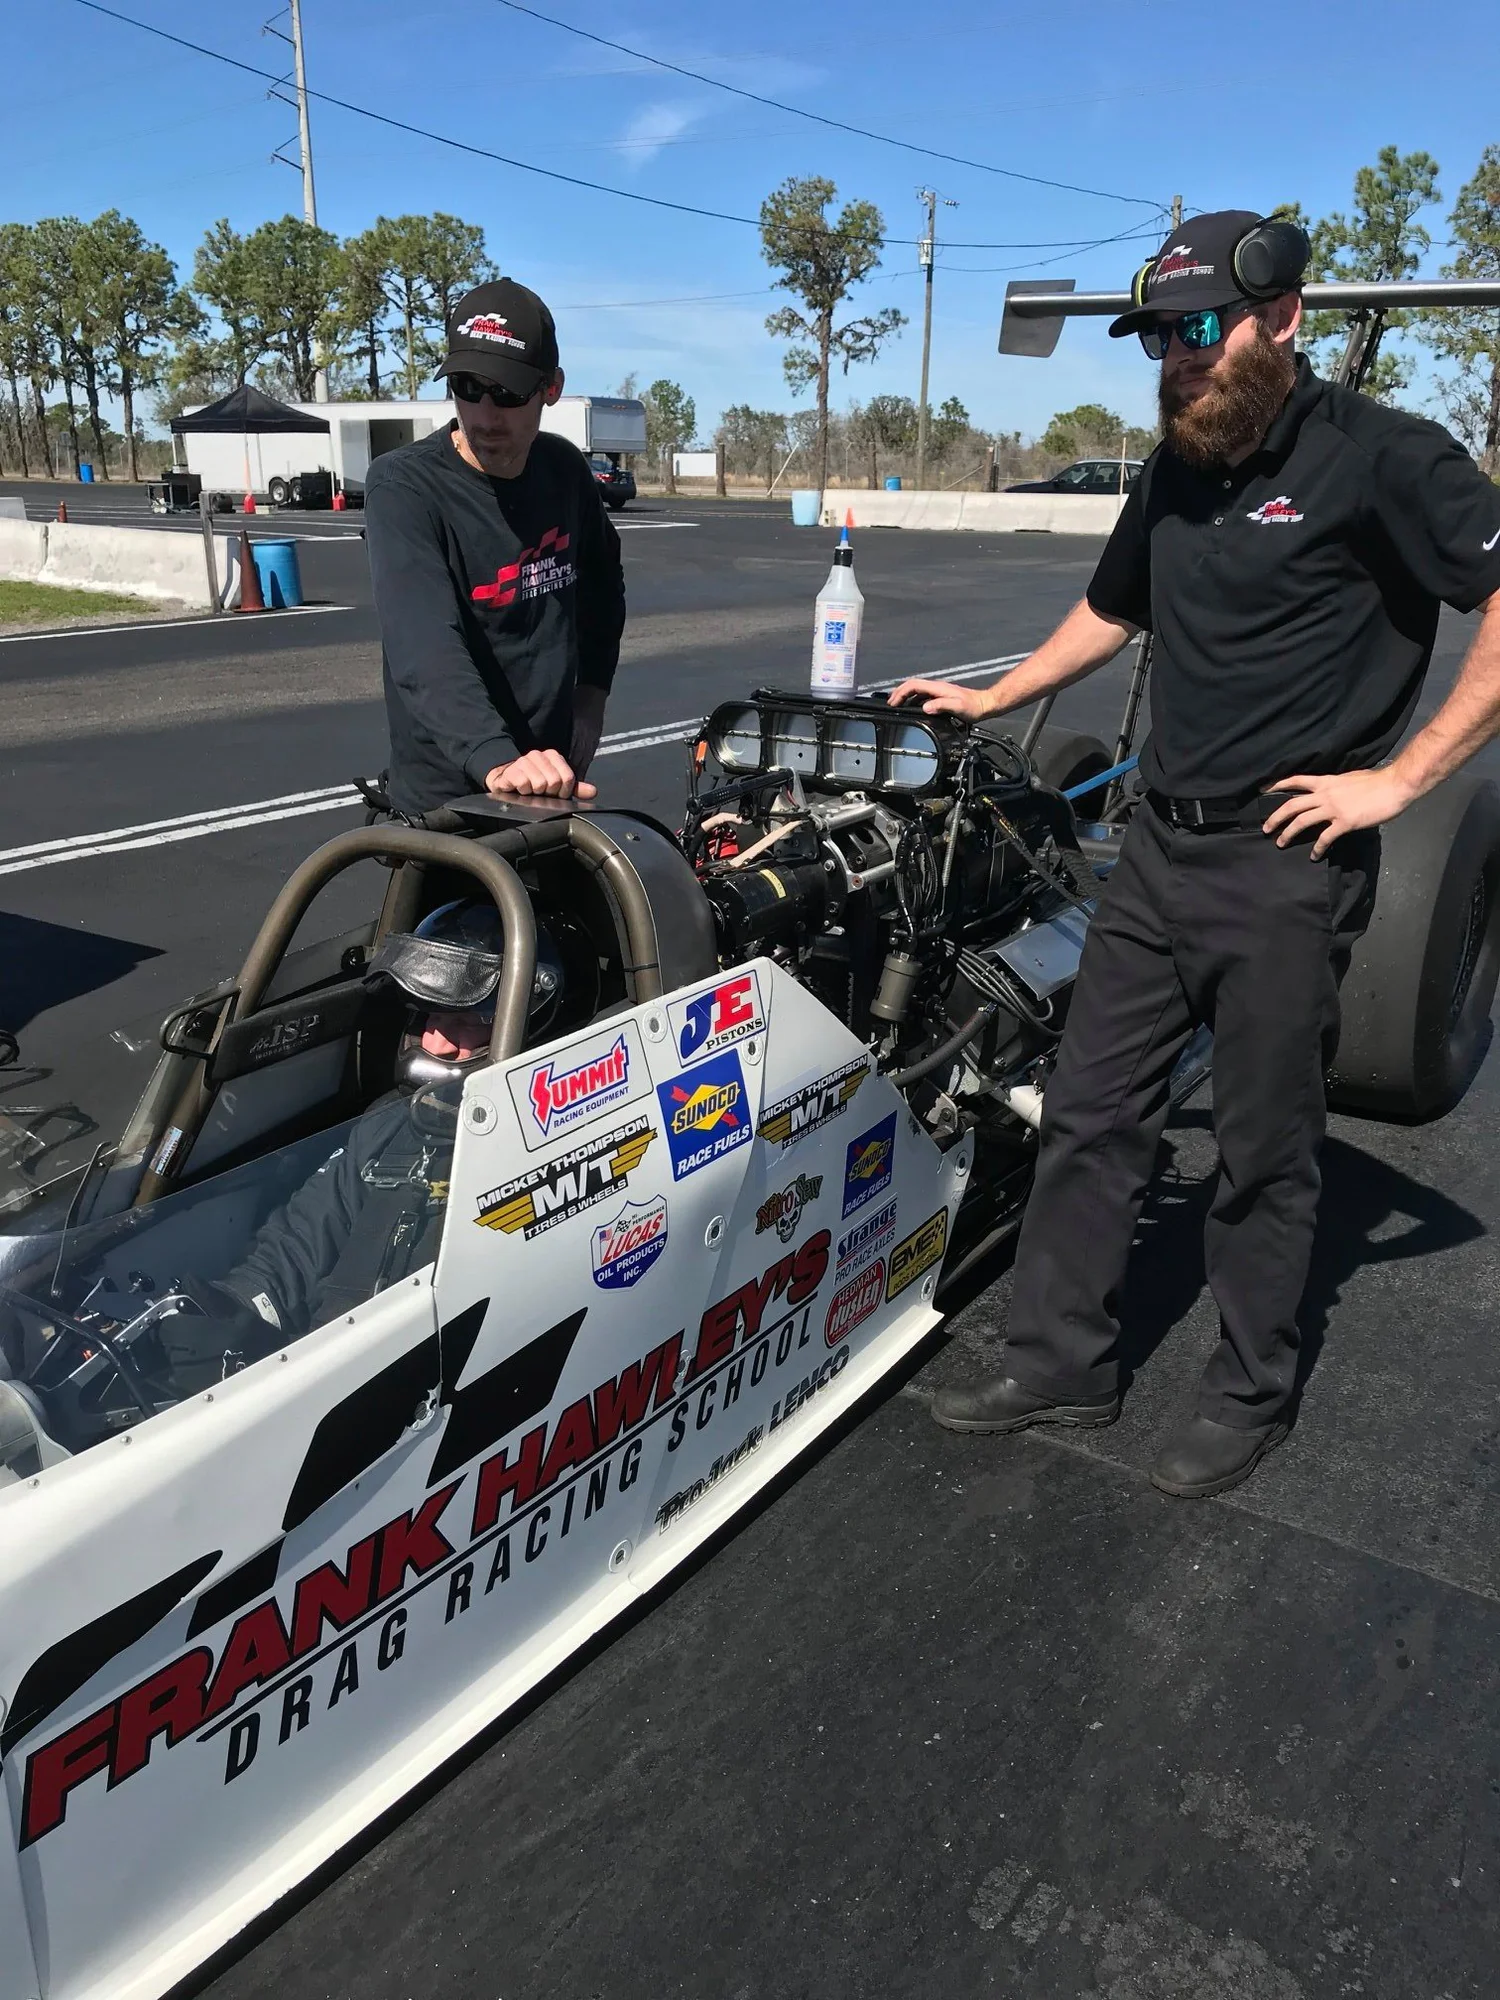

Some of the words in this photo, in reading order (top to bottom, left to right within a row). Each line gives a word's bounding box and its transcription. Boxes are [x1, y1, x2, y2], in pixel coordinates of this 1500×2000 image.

[522, 556, 556, 577] FRANK
[522, 563, 572, 589] HAWLEY'S
[680, 976, 754, 1060] JE
[705, 1017, 764, 1051] PISTONS
[554, 1108, 584, 1128] RACING
[586, 1086, 629, 1112] EQUIPMENT
[674, 1084, 738, 1133] SUNOCO
[760, 1090, 804, 1122] MICKEY
[805, 1055, 867, 1096] THOMPSON
[791, 1080, 846, 1133] M/T
[677, 1145, 712, 1176] RACE
[712, 1124, 751, 1162] FUELS
[782, 1128, 809, 1149] TIRES
[816, 1104, 846, 1128] WHEELS
[478, 1160, 549, 1210] MICKEY
[551, 1118, 648, 1173] THOMPSON
[532, 1150, 620, 1219] M/T
[850, 1140, 891, 1181] SUNOCO
[525, 1211, 566, 1239] TIRES
[567, 1205, 577, 1217] &
[576, 1179, 627, 1210] WHEELS
[844, 1189, 868, 1216] RACE
[867, 1172, 891, 1198] FUELS
[601, 1212, 664, 1265] LUCAS
[838, 1202, 897, 1260] Strange
[597, 1267, 614, 1282] OIL
[616, 1237, 665, 1272] PRODUCTS
[623, 1266, 642, 1281] INC.
[834, 1266, 852, 1286] PRO
[852, 1246, 873, 1273] RACE
[838, 1266, 877, 1305] HEDMAN
[769, 1344, 850, 1432] LENCO
[18, 1472, 469, 1853] FRANK
[470, 1229, 832, 1542] HAWLEY'S
[224, 1607, 408, 1785] DRAG
[444, 1438, 643, 1625] RACING
[667, 1306, 814, 1452] SCHOOL
